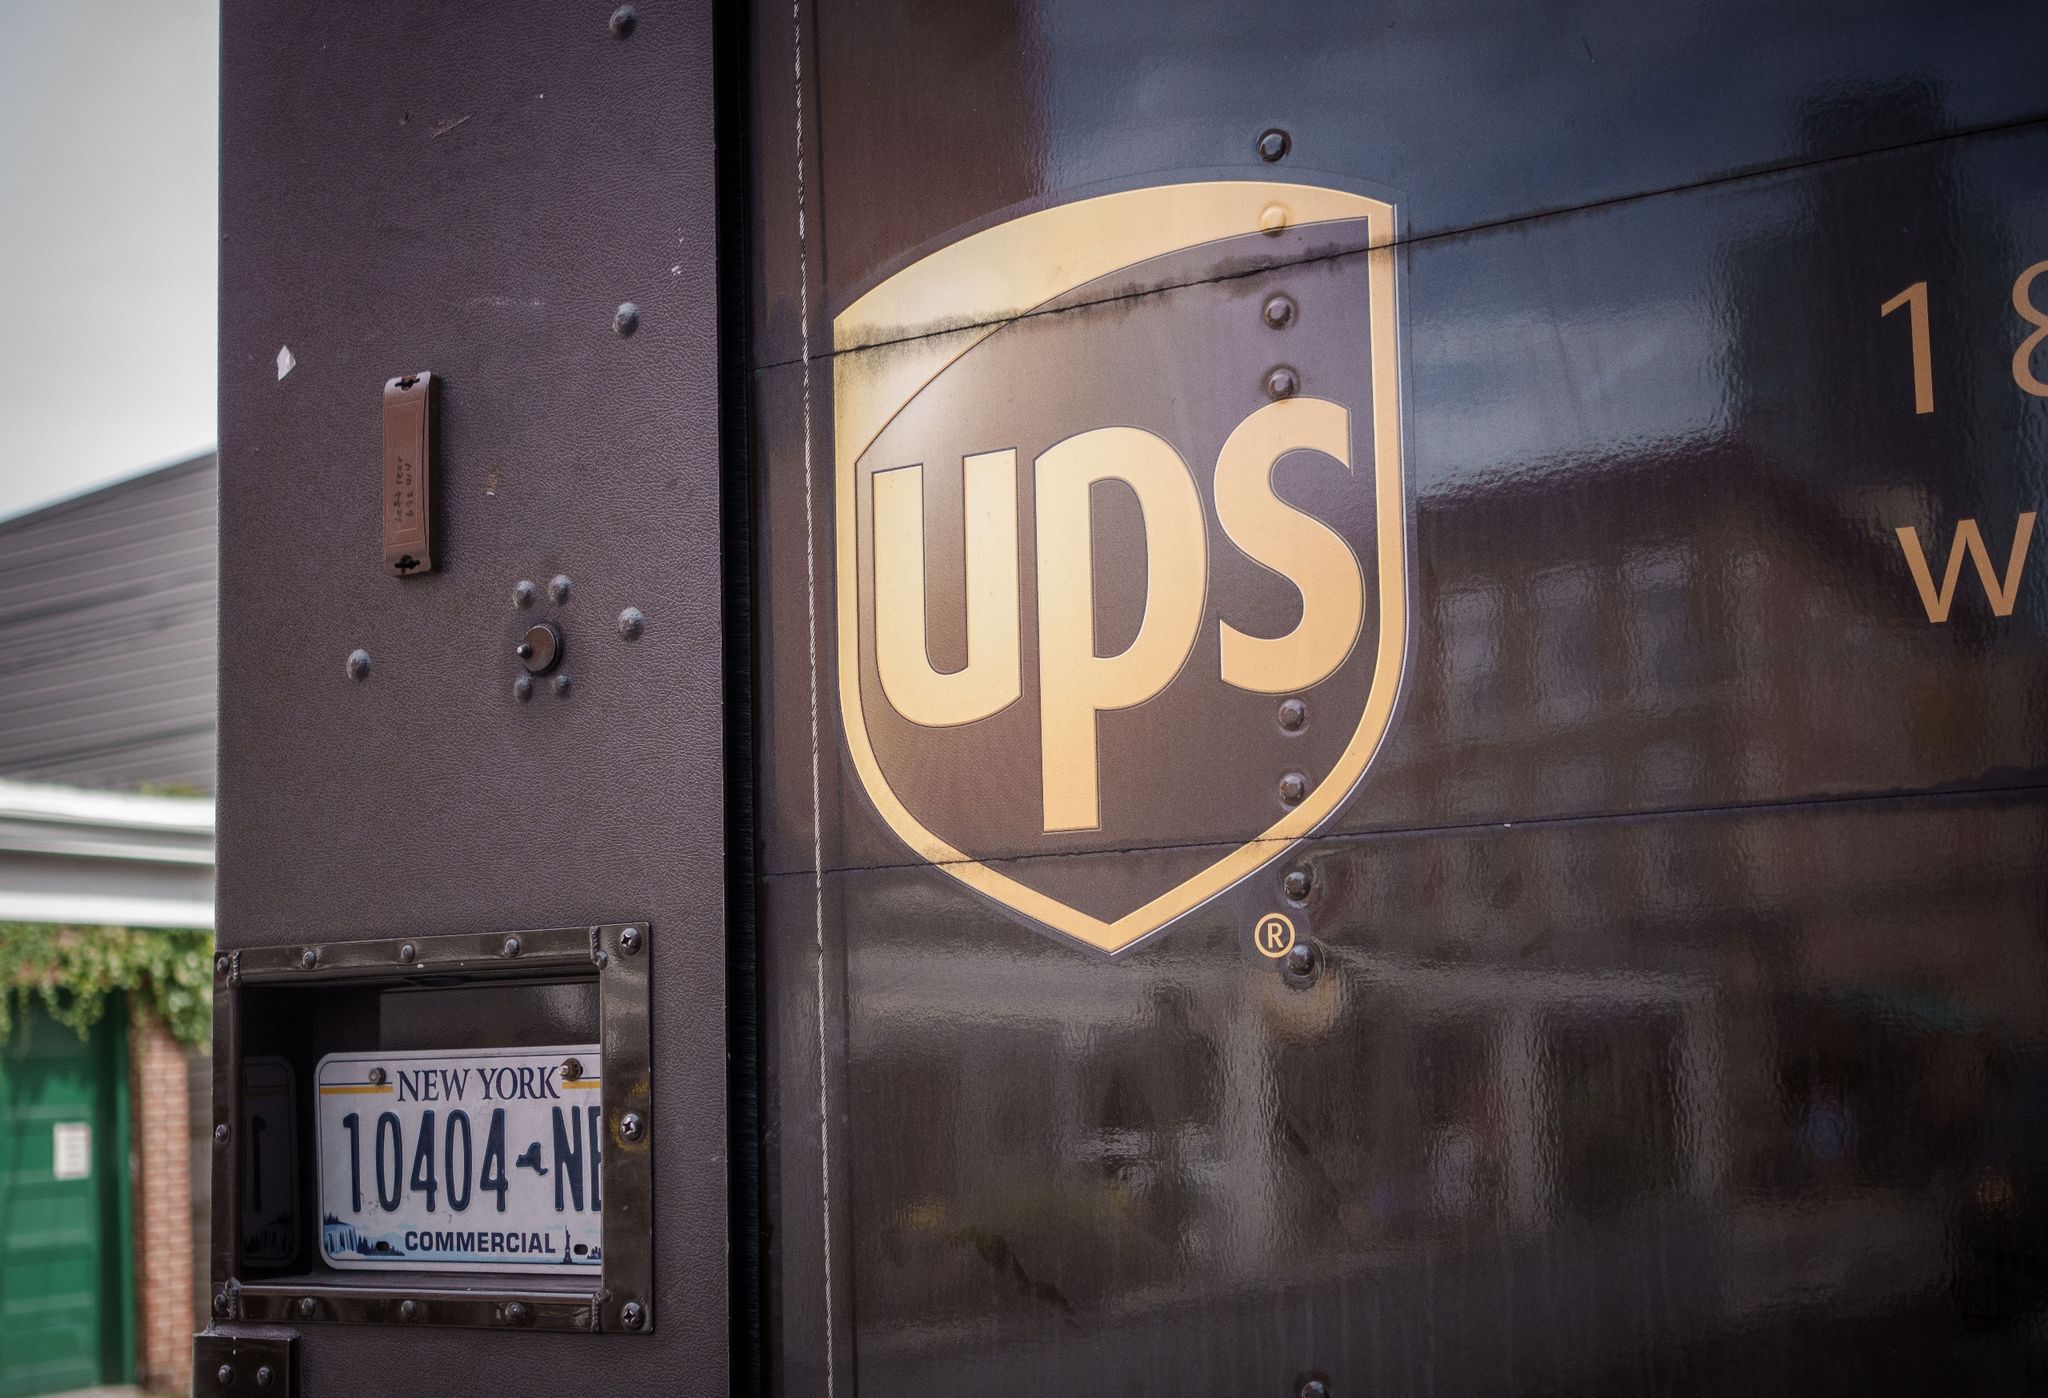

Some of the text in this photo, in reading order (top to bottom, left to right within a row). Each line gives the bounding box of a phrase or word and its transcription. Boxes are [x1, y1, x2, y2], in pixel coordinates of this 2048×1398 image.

[397, 1065, 560, 1102] NEW YORK
[405, 1231, 556, 1254] COMMERCIAL
